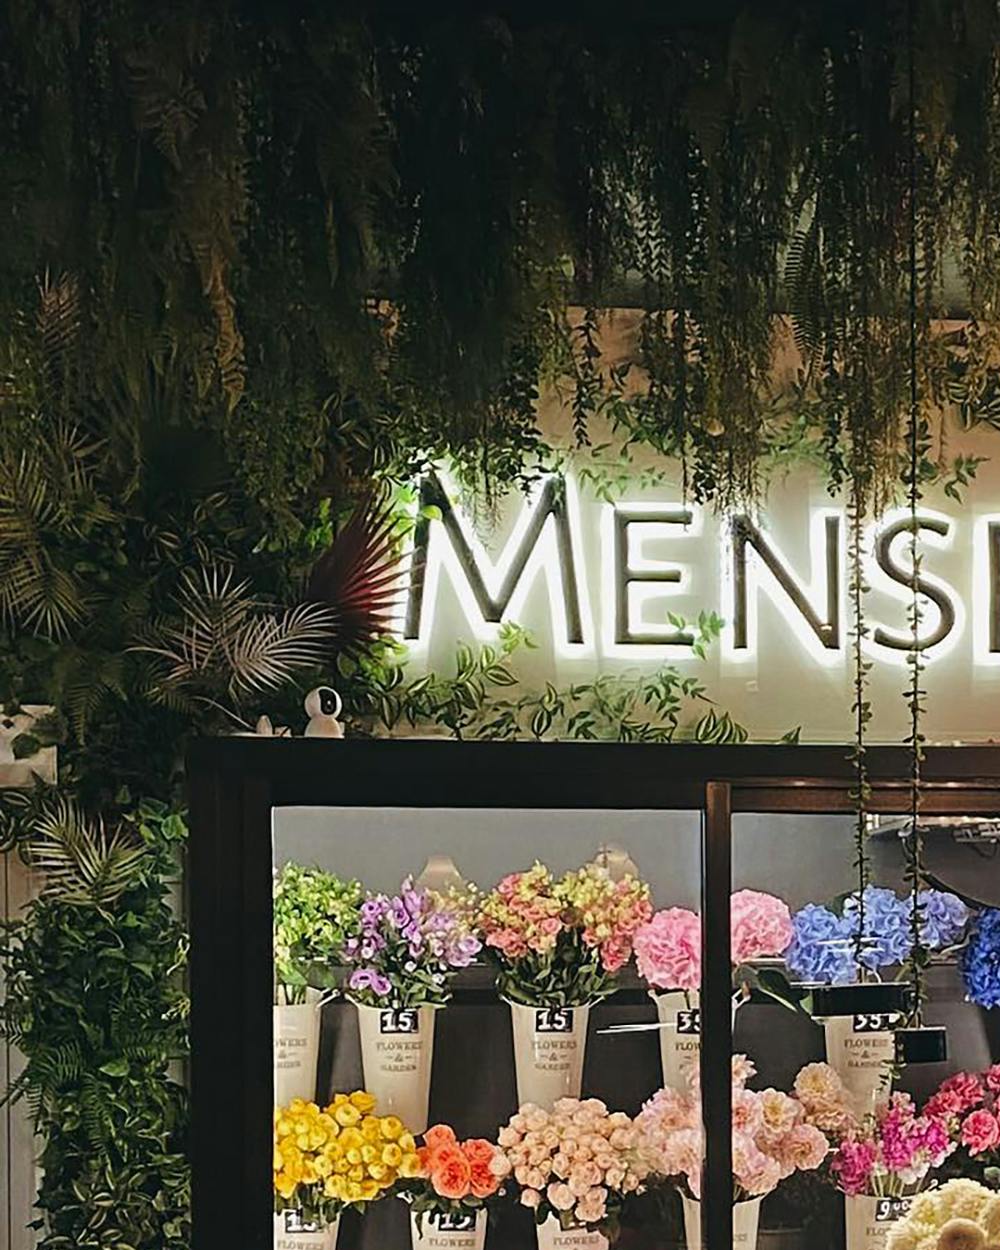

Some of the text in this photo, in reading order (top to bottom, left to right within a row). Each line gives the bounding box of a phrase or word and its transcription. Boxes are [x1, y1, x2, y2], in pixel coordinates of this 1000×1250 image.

[381, 1011, 412, 1032] 15
[537, 1010, 567, 1031] 15
[428, 1238, 476, 1248] FLOWERS
